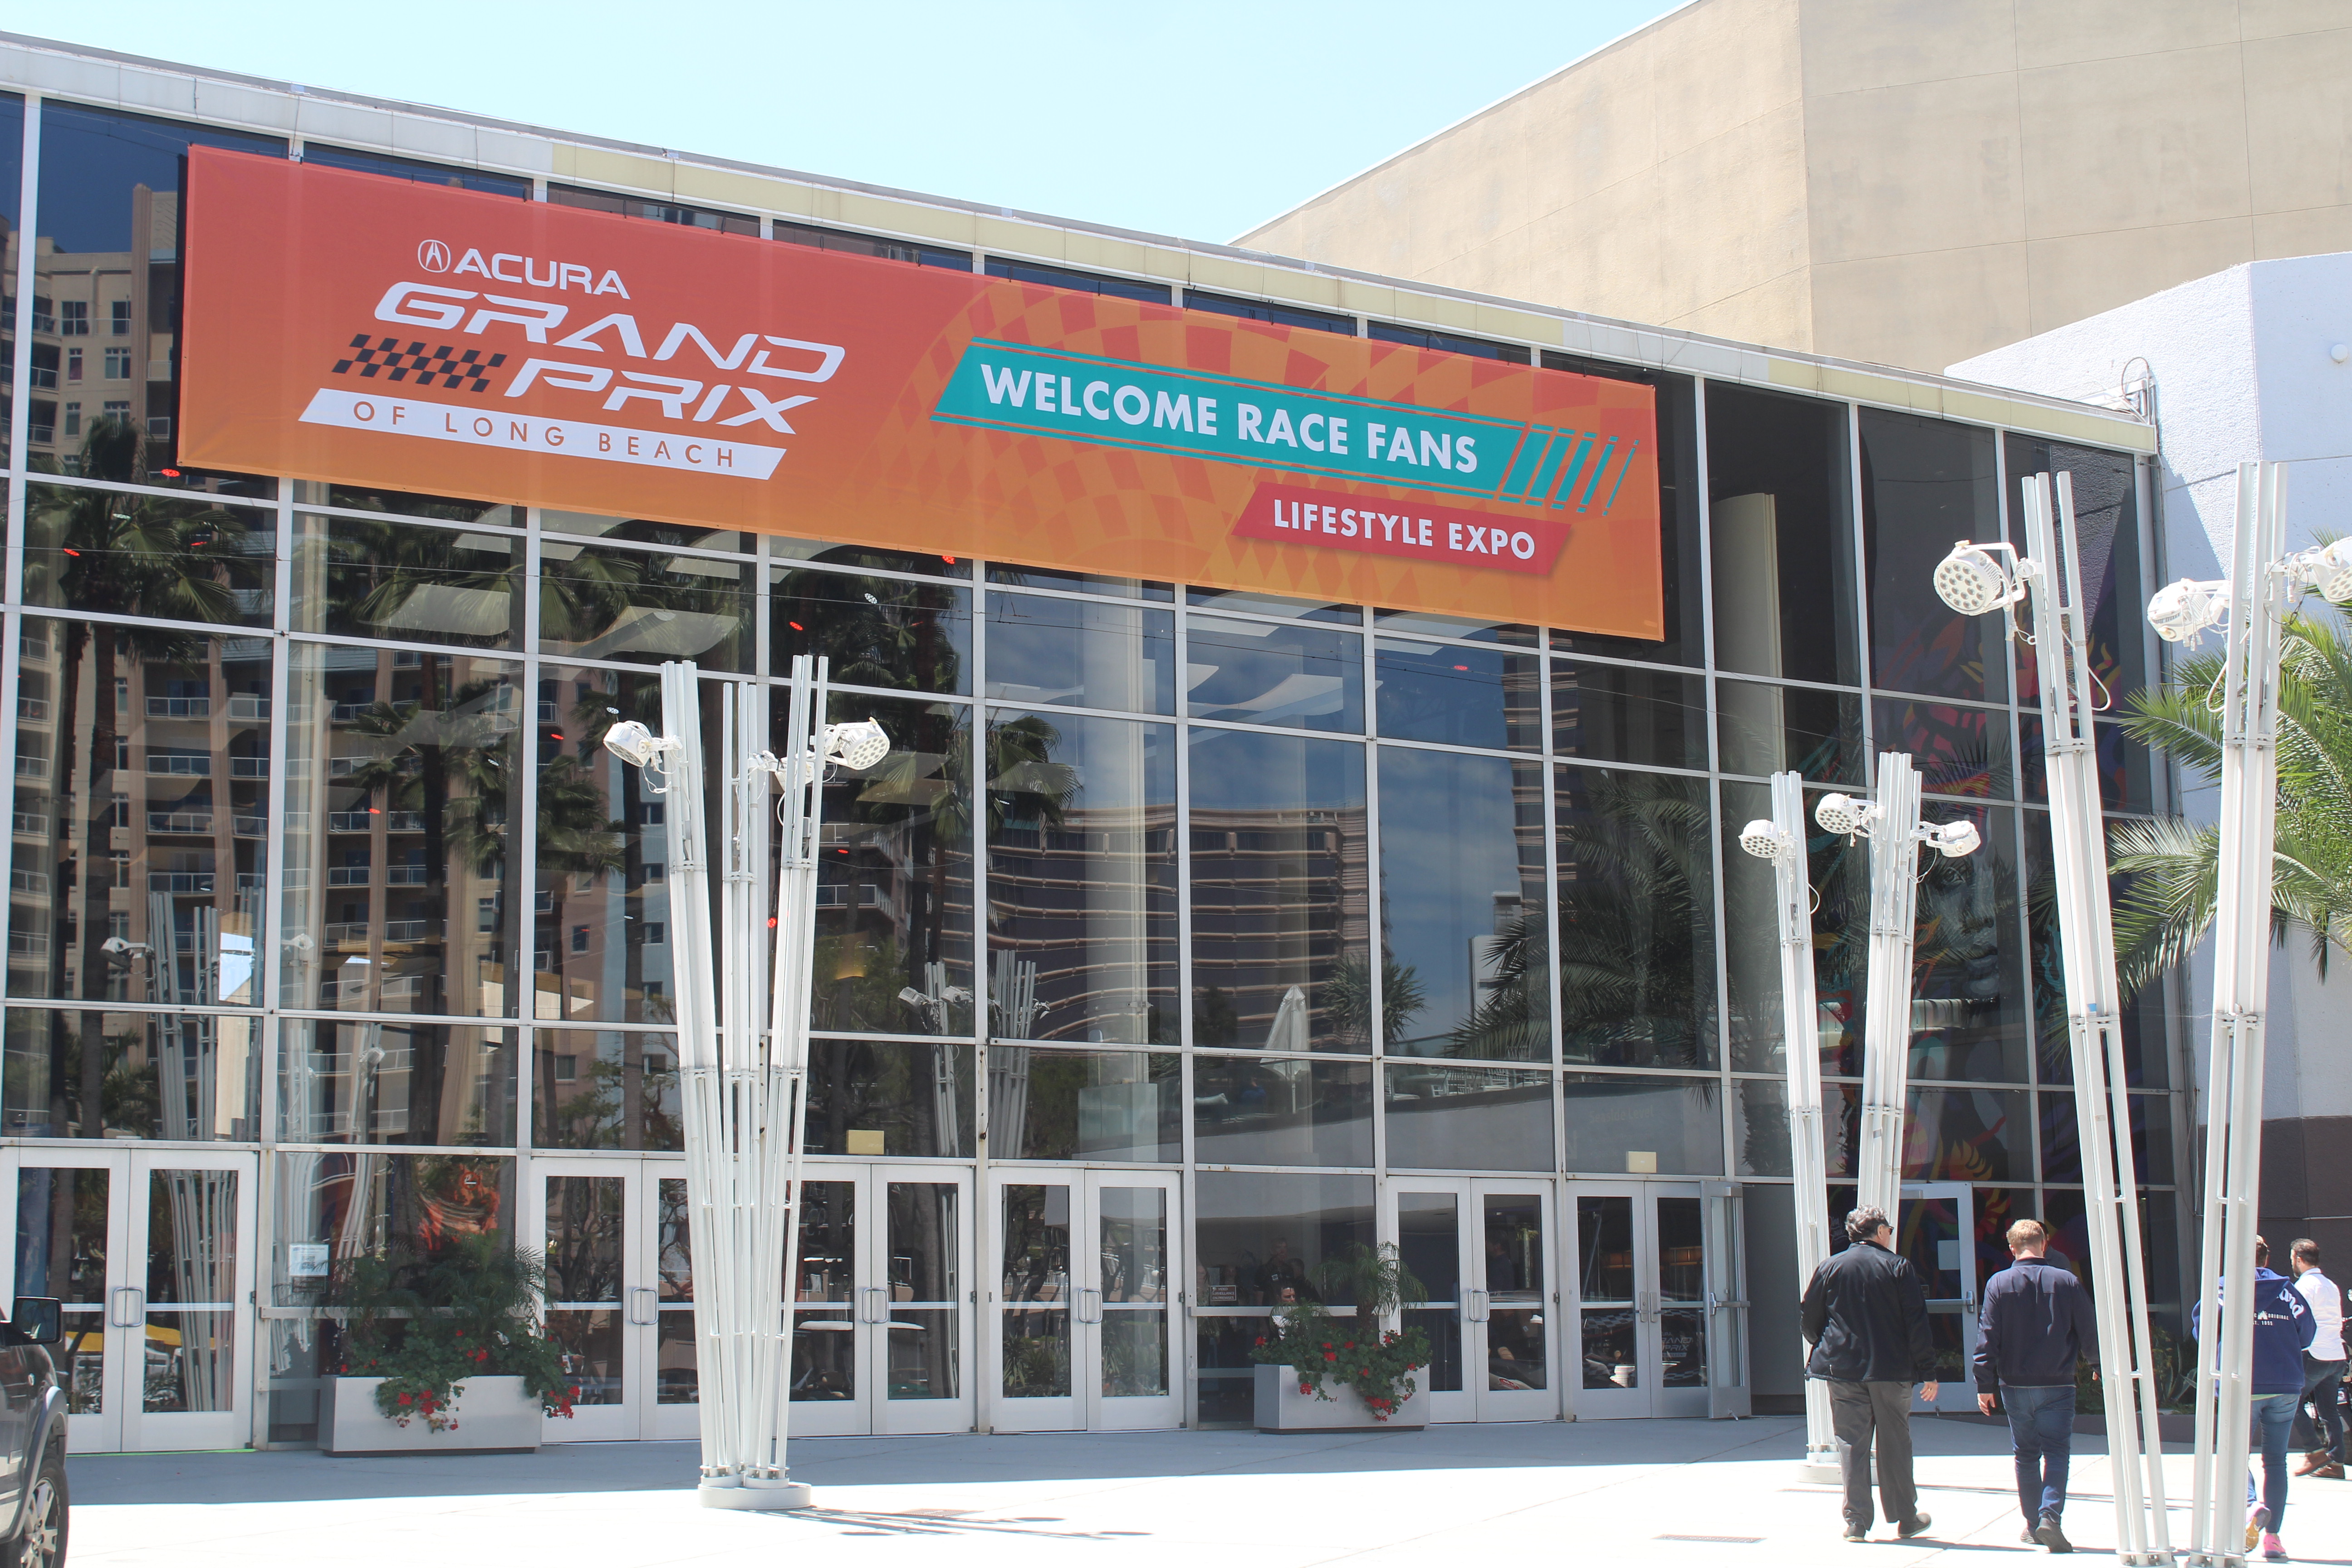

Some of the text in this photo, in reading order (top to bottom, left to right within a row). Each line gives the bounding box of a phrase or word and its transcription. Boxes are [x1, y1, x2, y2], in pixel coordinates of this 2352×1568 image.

[453, 248, 631, 299] ACURA
[374, 282, 845, 382] GRAND
[504, 358, 818, 434] PRIX
[981, 364, 1477, 473] WELCOME RACE FANS
[353, 401, 733, 468] OF LONG BEACH
[1274, 500, 1535, 559] LIFESTYLE EXPO
